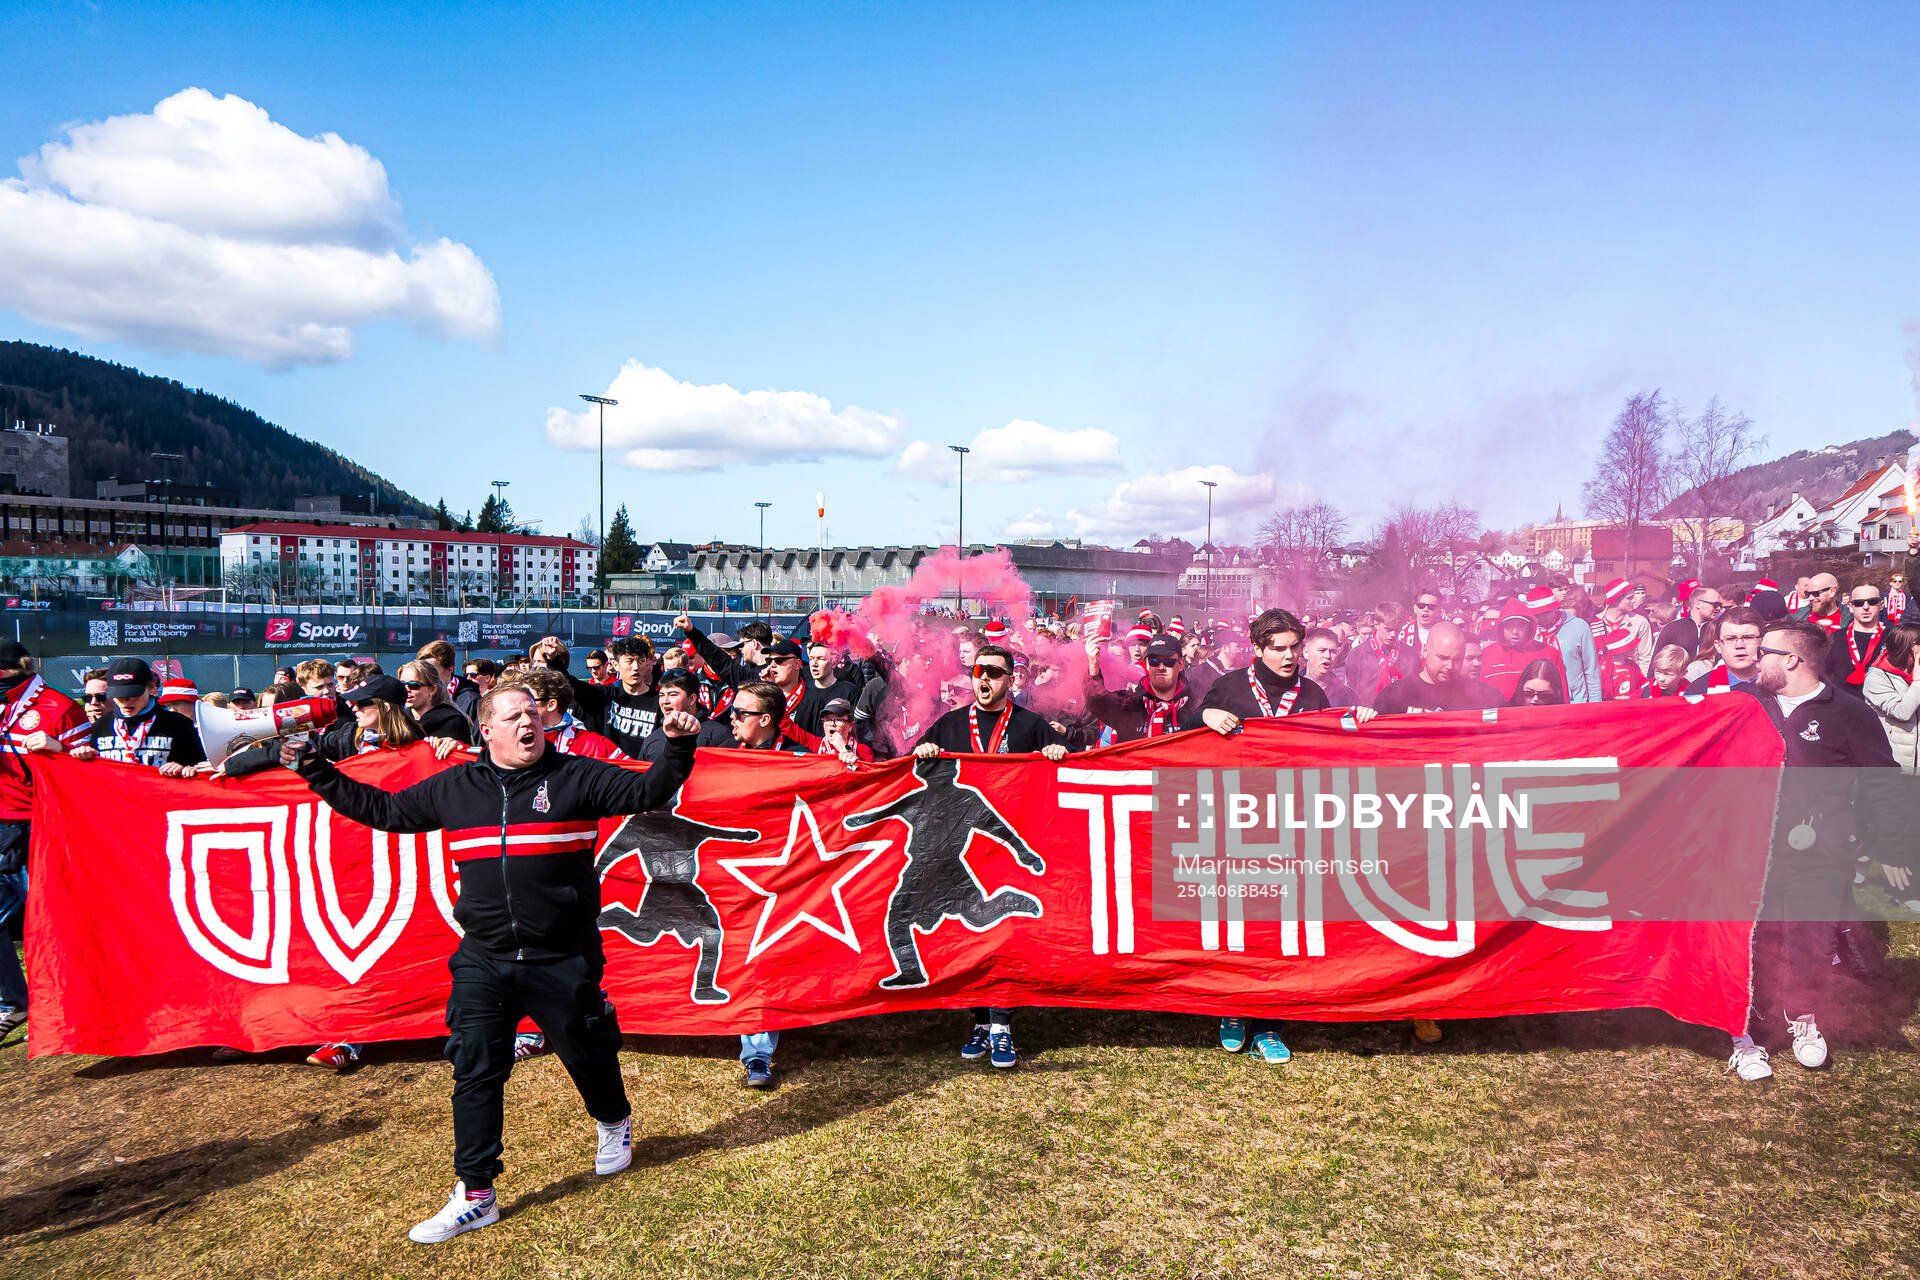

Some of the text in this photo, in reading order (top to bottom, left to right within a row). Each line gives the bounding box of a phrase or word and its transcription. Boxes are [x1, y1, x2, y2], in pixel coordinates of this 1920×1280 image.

[152, 623, 196, 631] QR-koden
[298, 622, 360, 641] Sporty
[634, 620, 676, 636] Sporty
[619, 706, 657, 724] BRANN
[97, 736, 114, 750] SK
[166, 800, 465, 985] OV
